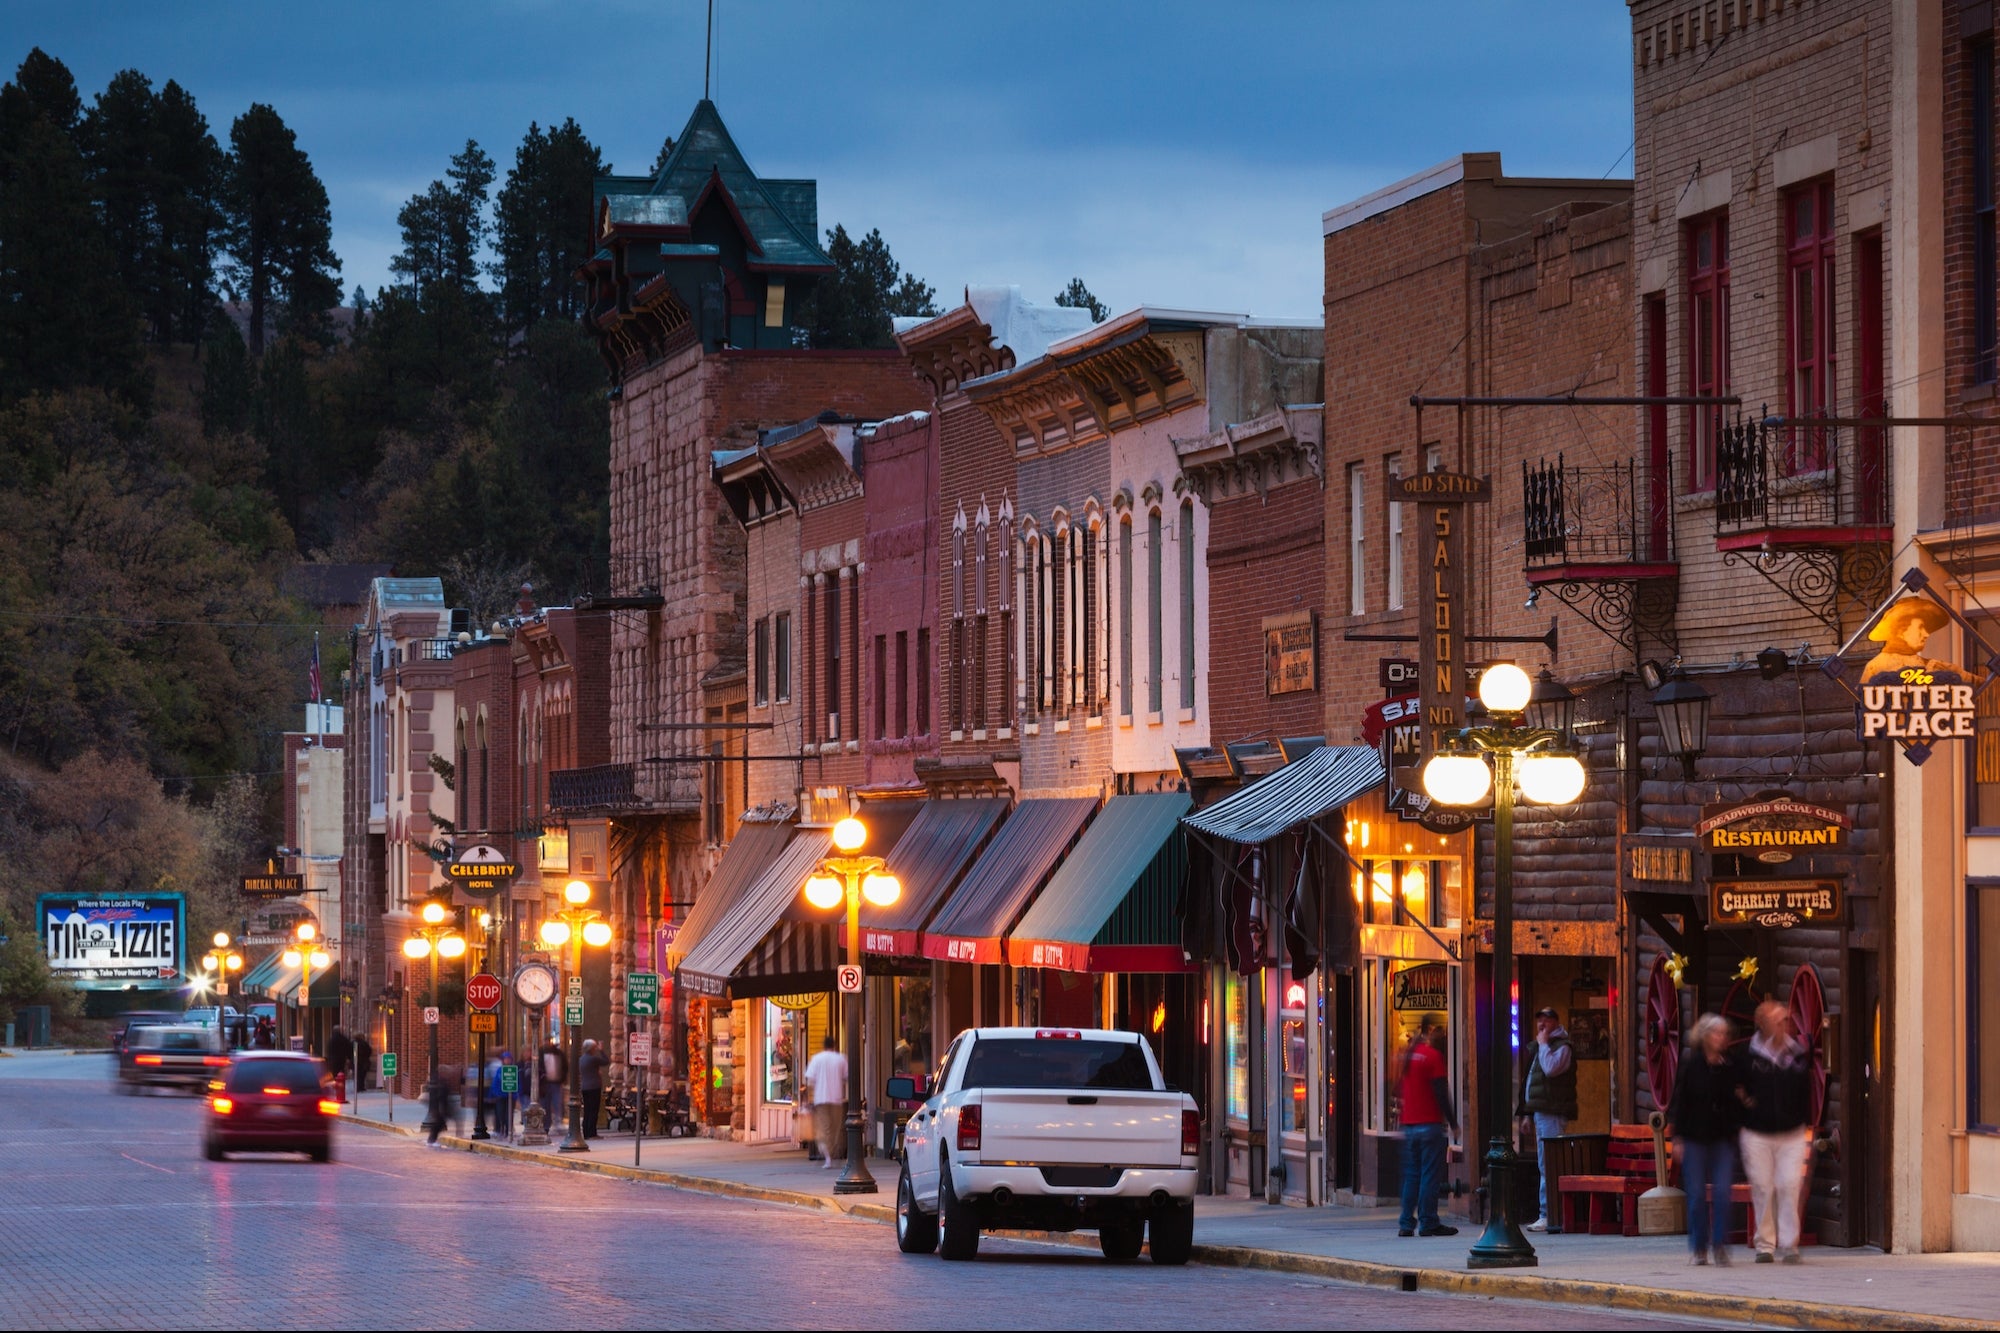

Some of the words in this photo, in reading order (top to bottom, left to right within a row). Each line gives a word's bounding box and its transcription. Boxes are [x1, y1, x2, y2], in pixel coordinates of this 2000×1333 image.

[1404, 476, 1433, 493] OLD
[1437, 475, 1480, 493] STYLE
[1434, 508, 1452, 693] SALOON
[1900, 669, 1934, 685] The
[1863, 684, 1975, 711] UTTER
[1863, 711, 1975, 737] PLACE
[1435, 815, 1460, 824] 1876
[1709, 804, 1770, 829] DEADWOOD
[1773, 803, 1812, 814] SOCIAL
[1815, 808, 1843, 823] CLUB
[1712, 825, 1840, 847] RESTAURANT
[450, 864, 515, 876] CELEBRITY
[245, 879, 272, 890] MINERAL
[274, 879, 297, 889] PALACE
[77, 900, 98, 908] Where
[99, 900, 110, 908] the
[110, 900, 131, 908] Locals
[131, 900, 145, 909] Play
[1722, 891, 1780, 912] CHARLEY
[1786, 889, 1832, 910] UTTER
[50, 923, 86, 958] TIN
[109, 921, 171, 958] LIZZIE
[99, 969, 114, 977] Take
[114, 968, 128, 977] Your
[128, 968, 141, 977] Next
[141, 967, 157, 978] Right
[469, 985, 499, 999] STOP
[1408, 995, 1441, 1008] TRADING
